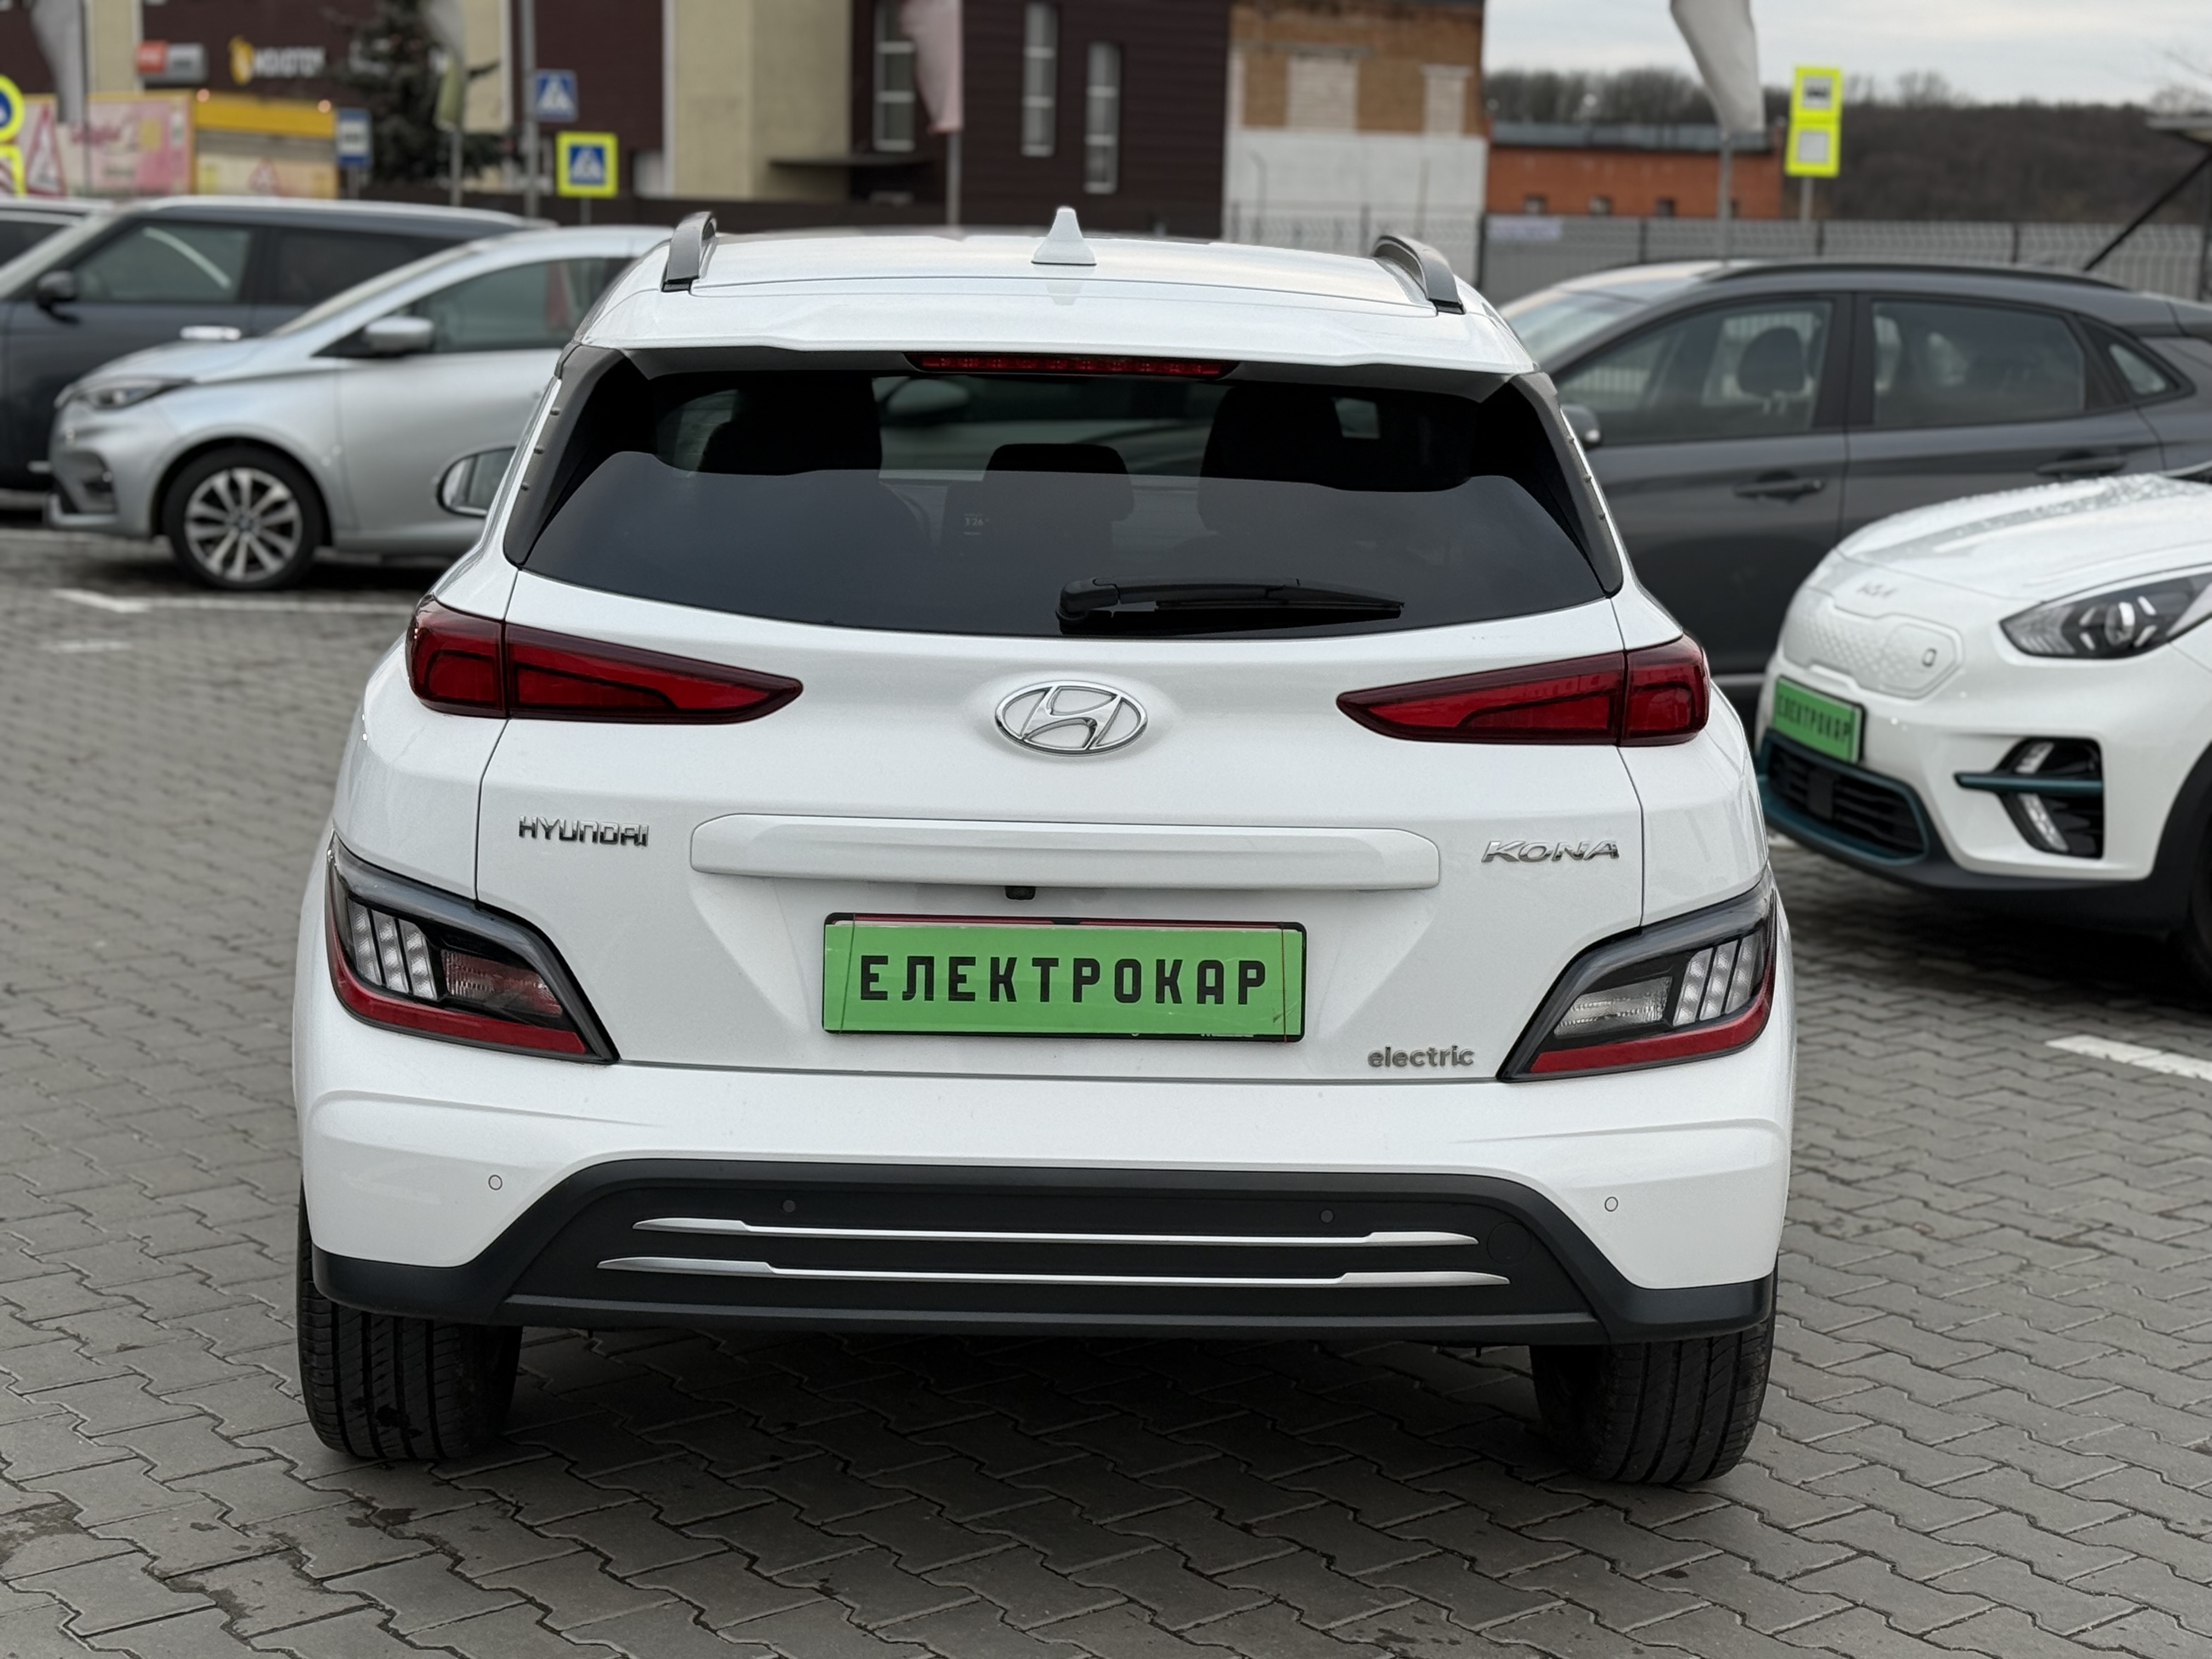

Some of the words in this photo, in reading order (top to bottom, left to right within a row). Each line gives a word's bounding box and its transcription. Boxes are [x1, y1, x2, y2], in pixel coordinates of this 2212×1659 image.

[518, 815, 649, 847] HYUNDAI
[1481, 840, 1620, 863] KONA
[860, 955, 1266, 1005] ЕЛЕКТРОКАР
[1368, 1045, 1475, 1068] electric
